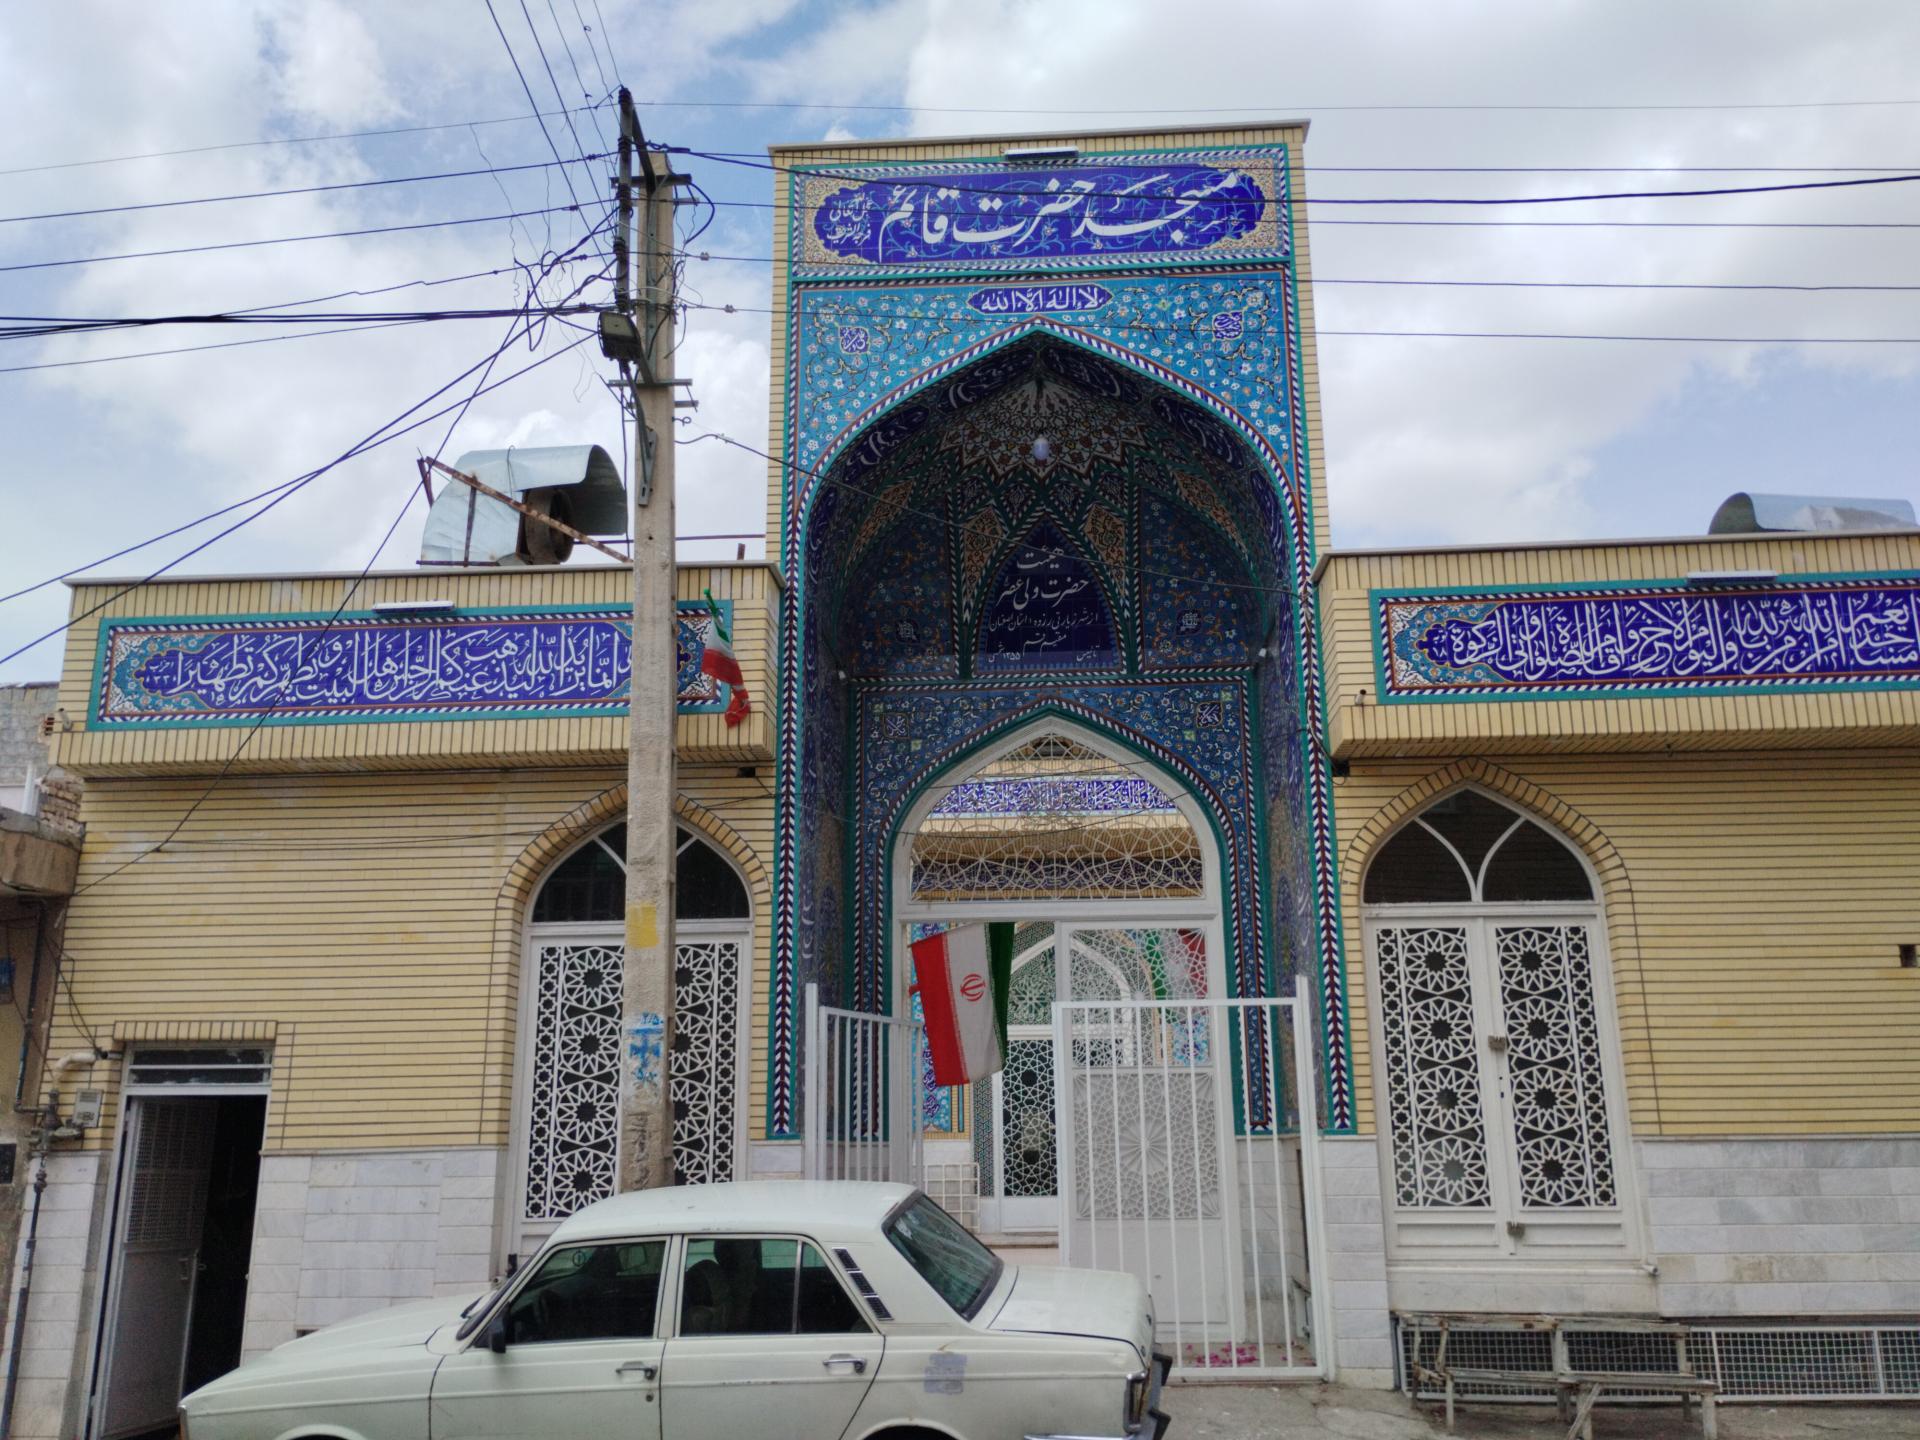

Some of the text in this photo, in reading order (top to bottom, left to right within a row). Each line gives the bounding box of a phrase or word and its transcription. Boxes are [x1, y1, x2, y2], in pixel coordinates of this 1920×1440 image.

[878, 172, 1239, 263] مسجد حضرت قائم
[980, 289, 1015, 312] الله
[995, 577, 1025, 607] عصر
[1040, 576, 1089, 608] حضرت
[1086, 611, 1098, 625] از
[1023, 632, 1067, 656] مقیم قم
